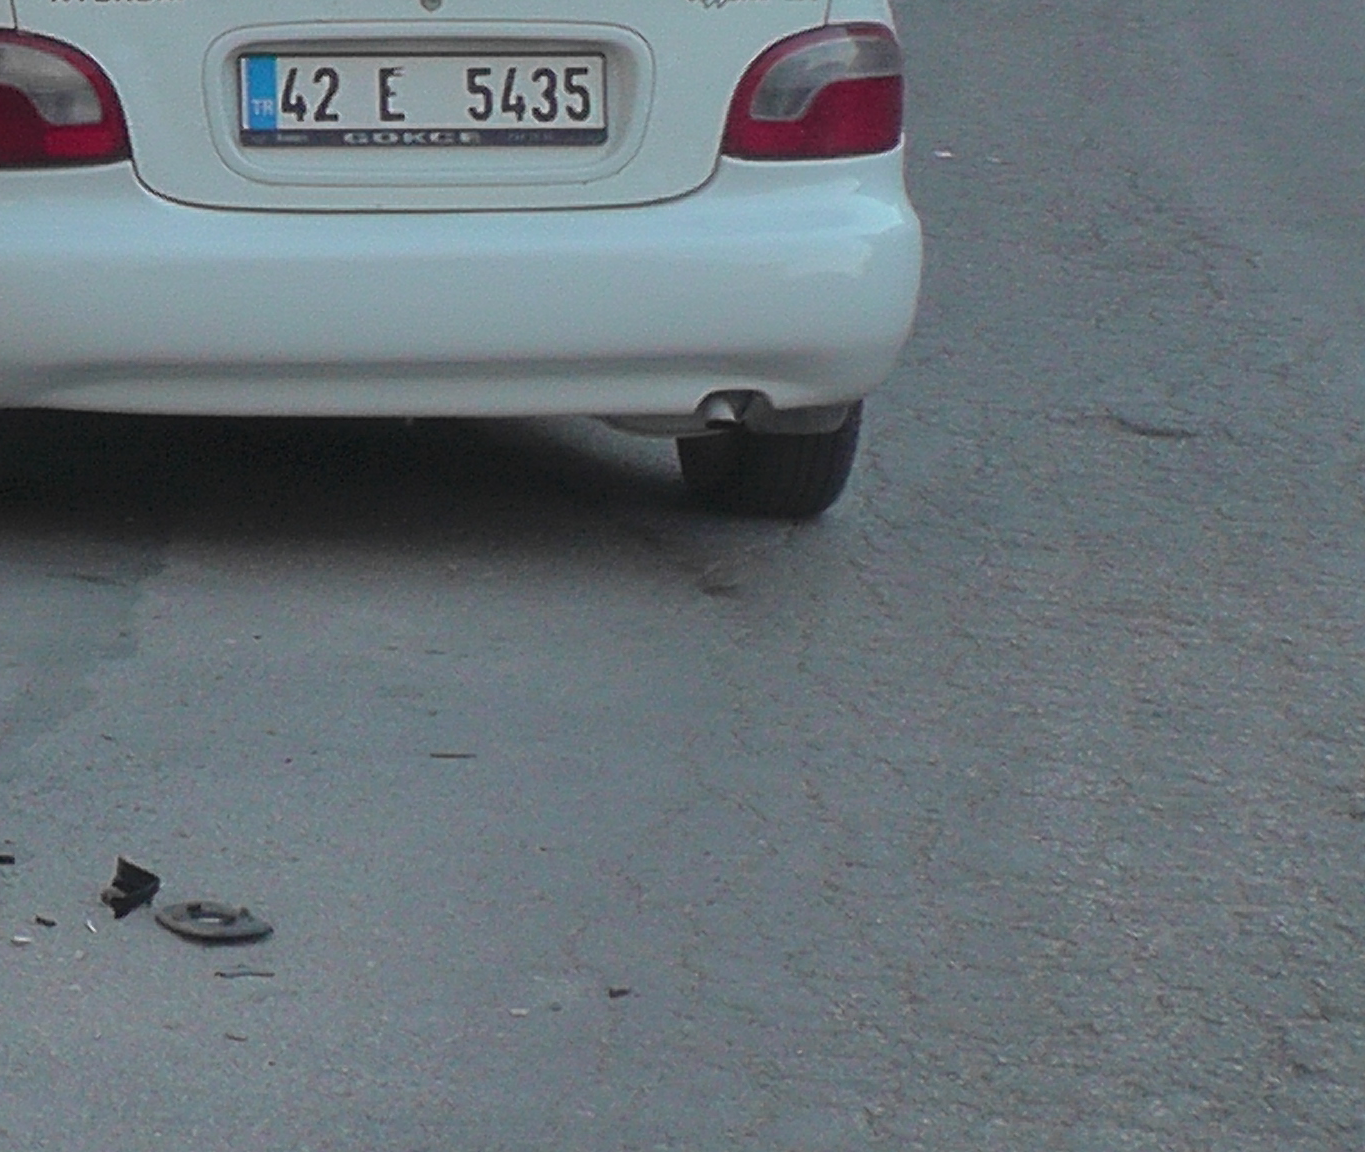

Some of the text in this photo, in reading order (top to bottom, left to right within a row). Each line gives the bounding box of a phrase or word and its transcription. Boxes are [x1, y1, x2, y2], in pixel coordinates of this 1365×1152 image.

[280, 66, 591, 123] 42 E 5435
